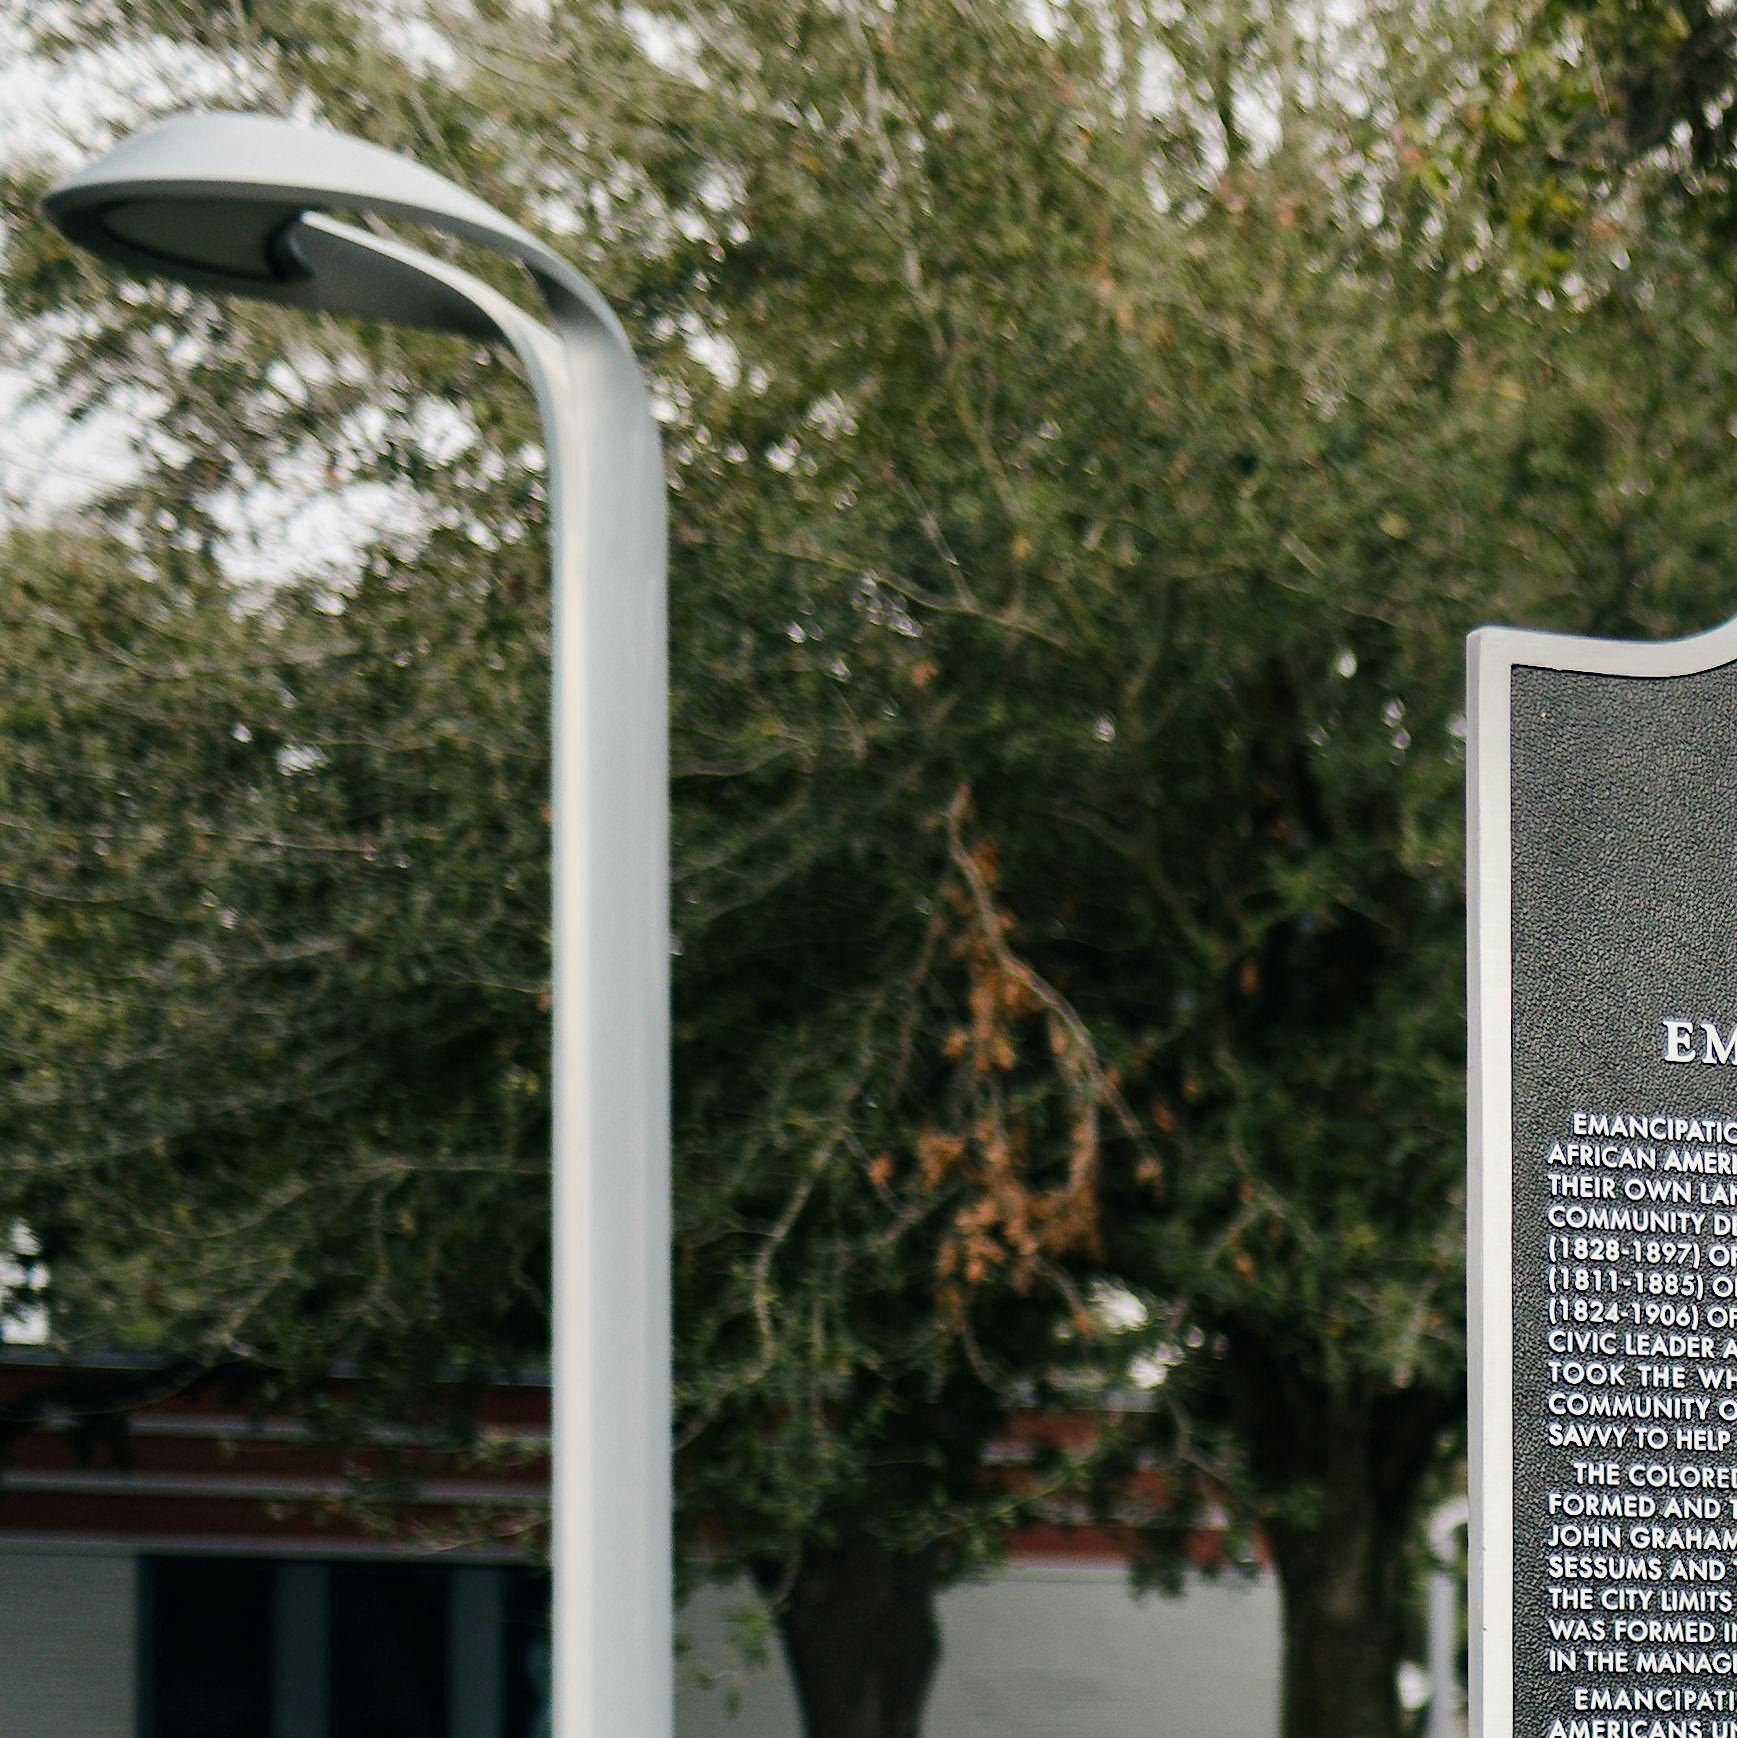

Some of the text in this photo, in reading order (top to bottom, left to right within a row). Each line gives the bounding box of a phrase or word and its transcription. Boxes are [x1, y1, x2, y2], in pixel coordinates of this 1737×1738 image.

[1547, 1173, 1616, 1199] THEIR
[1624, 1178, 1691, 1203] OWN
[1549, 1235, 1700, 1268] (1828-1897)
[1549, 1297, 1699, 1329] (1824-1906)
[1548, 1361, 1625, 1386] TOOK
[1636, 1363, 1686, 1389] THE
[1548, 1422, 1627, 1448] SAVVY
[1632, 1425, 1669, 1449] TO
[1676, 1427, 1730, 1451] HELP
[1549, 1493, 1656, 1517] FORMED
[1663, 1497, 1721, 1519] AND
[1546, 1555, 1663, 1581] SESSUMS
[1670, 1559, 1726, 1581] AND
[1548, 1618, 1606, 1641] WAS
[1615, 1620, 1715, 1643] FORMED
